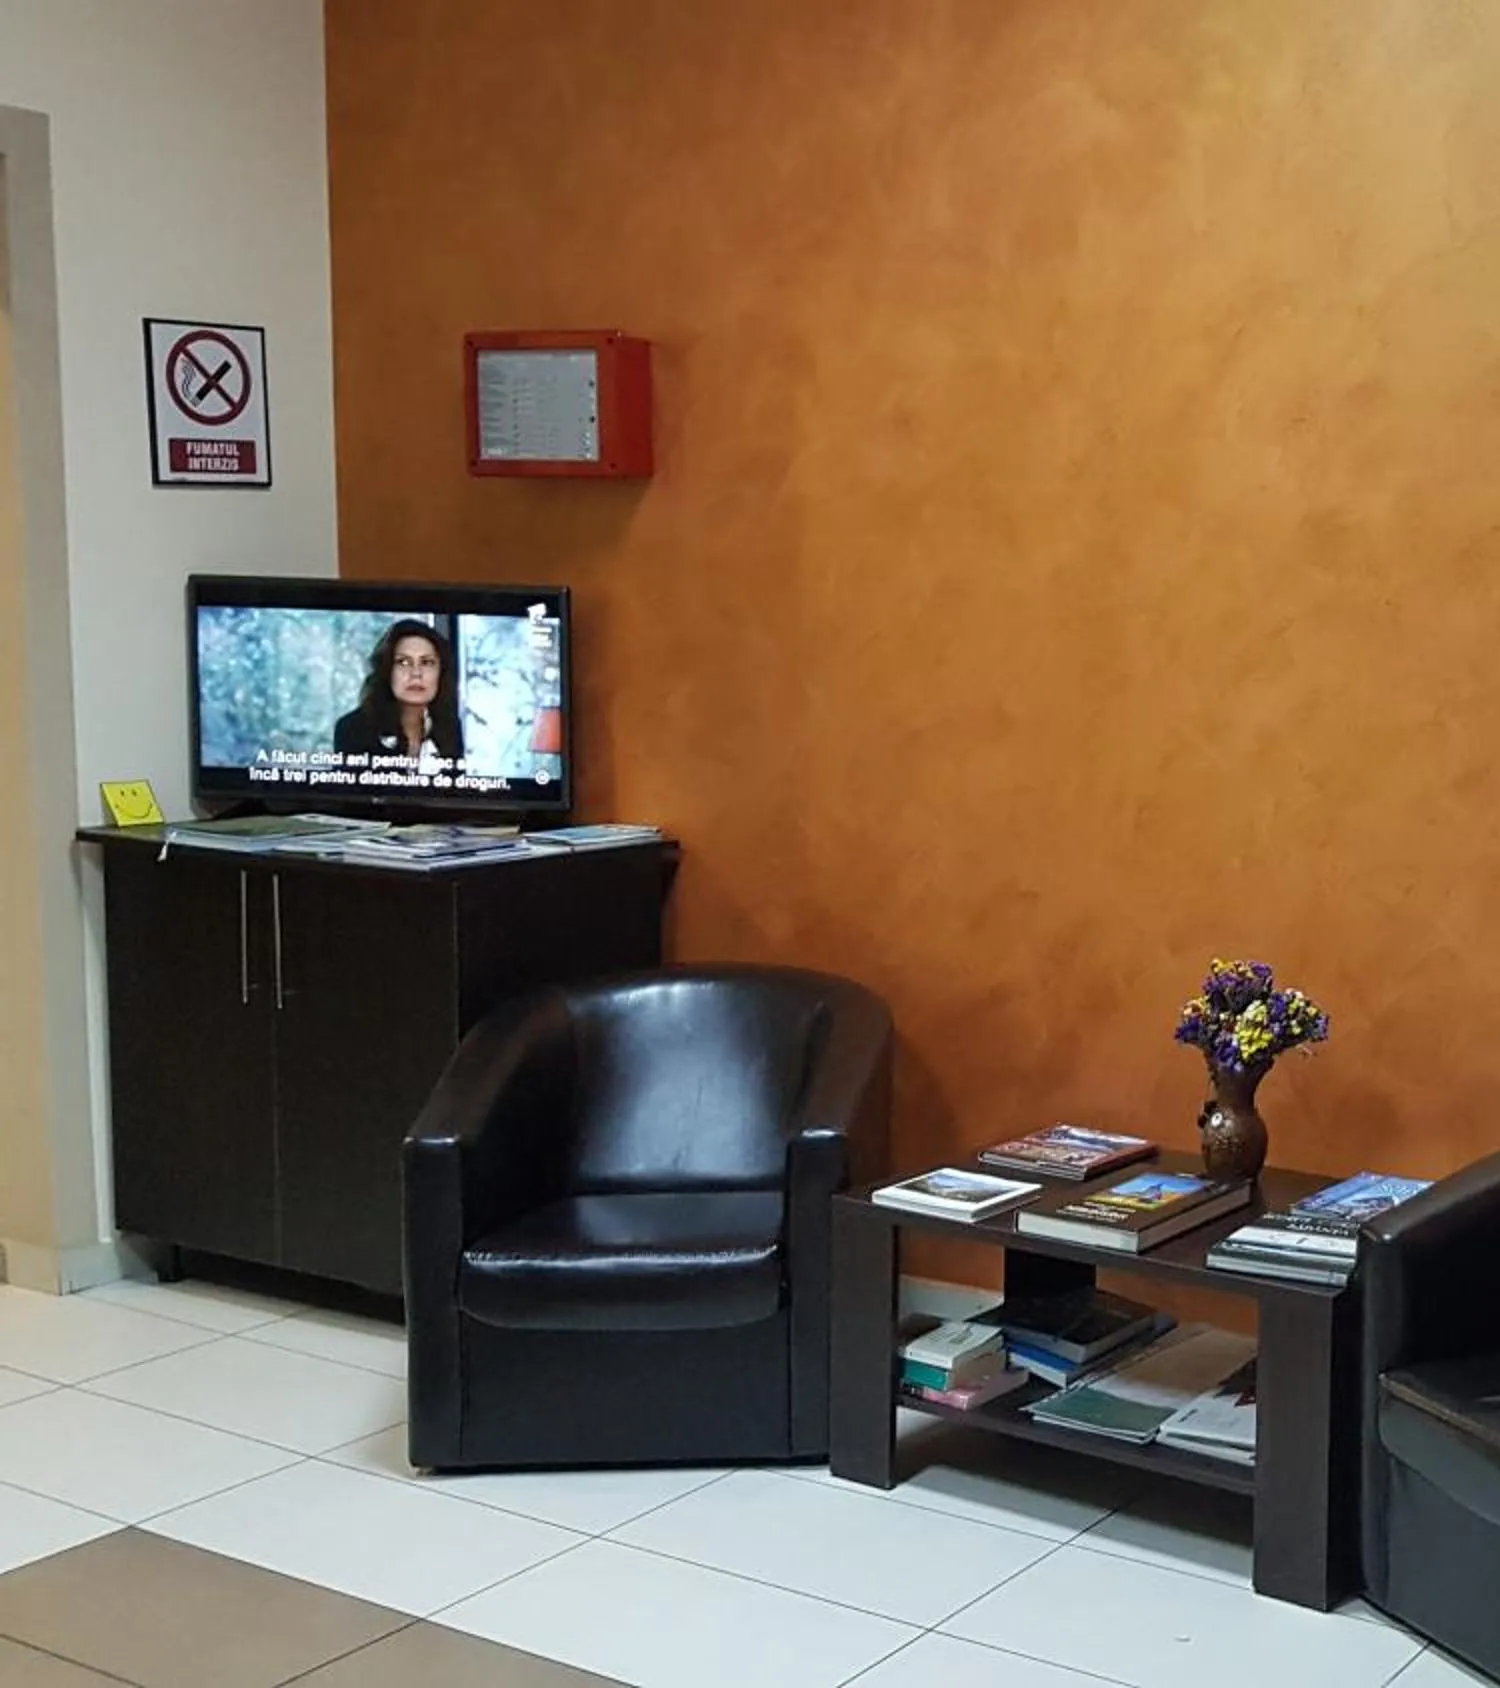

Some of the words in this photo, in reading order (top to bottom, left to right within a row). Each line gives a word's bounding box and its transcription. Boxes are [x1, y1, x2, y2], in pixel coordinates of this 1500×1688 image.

[186, 441, 240, 456] FUMATUL
[188, 457, 239, 471] INTERZIS
[256, 751, 269, 763] A
[310, 752, 344, 766] cinci
[346, 754, 369, 767] ani
[372, 754, 418, 771] pentru
[283, 768, 307, 782] trei
[309, 770, 356, 785] pentru
[359, 771, 430, 787] distribuire
[433, 774, 453, 788] de
[455, 775, 512, 792] droguri.
